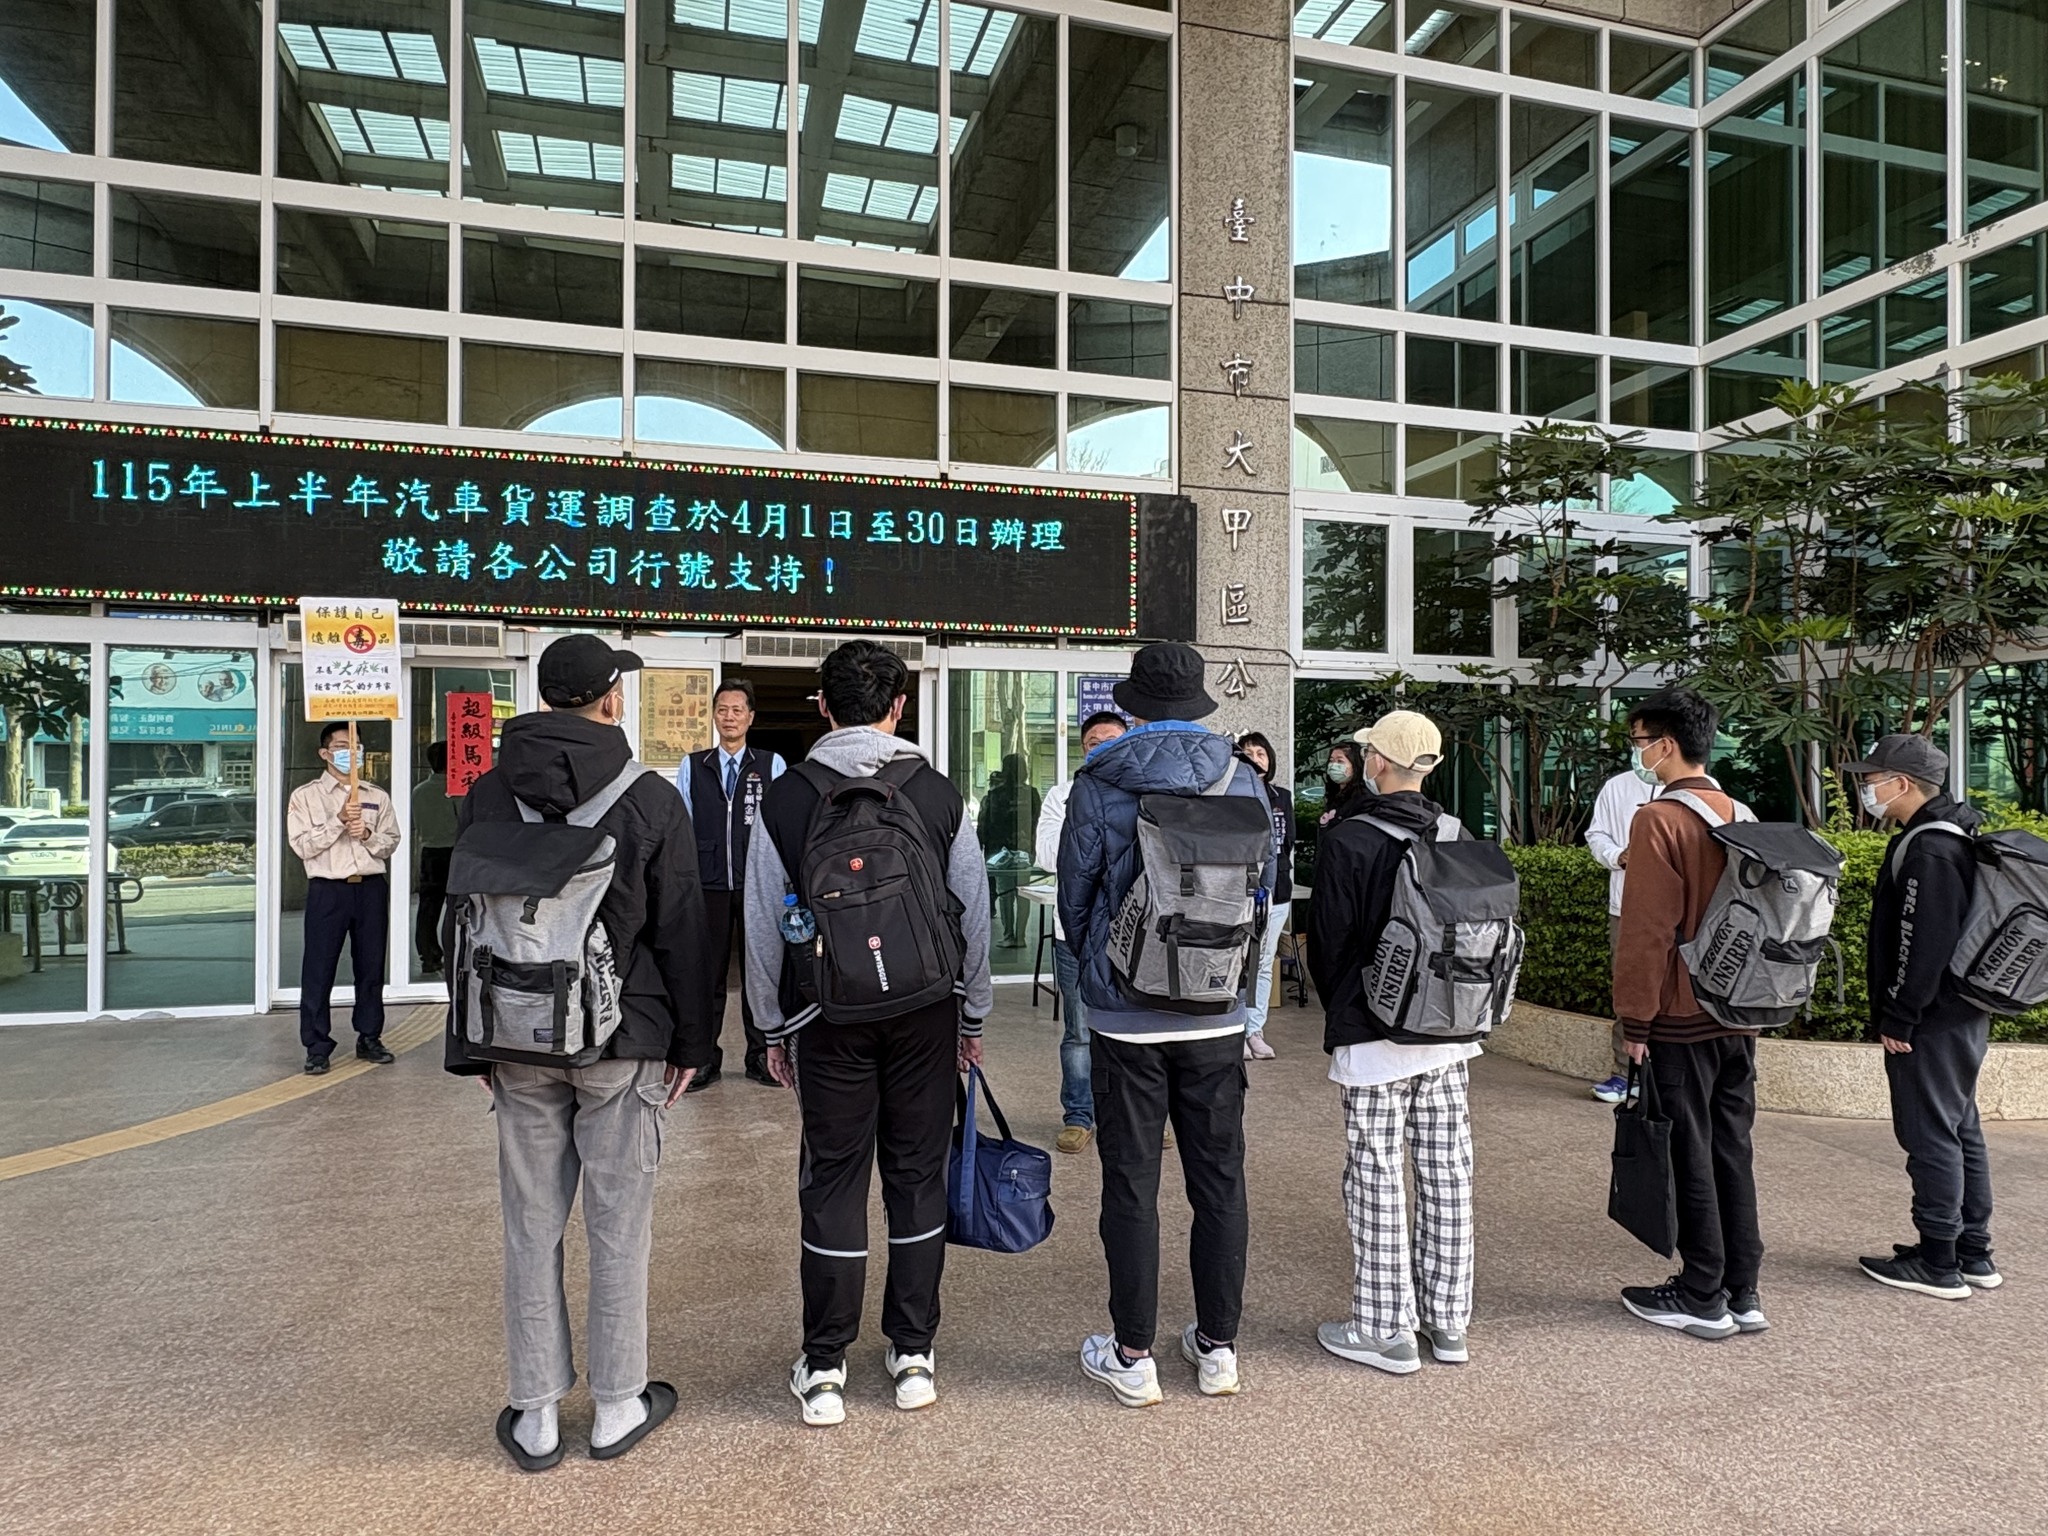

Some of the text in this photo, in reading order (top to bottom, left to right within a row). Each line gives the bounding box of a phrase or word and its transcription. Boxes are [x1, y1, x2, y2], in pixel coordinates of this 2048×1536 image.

[1217, 197, 1256, 743] 臺中市大甲區公
[316, 605, 384, 620] 保護自己
[311, 627, 390, 649] 遠離毒品
[1083, 682, 1114, 691] 臺中市
[1902, 877, 1919, 916] SPEC.
[873, 950, 889, 992] SWISSGEAR
[1700, 921, 1735, 976] FASHION
[1711, 929, 1755, 990] INSIRER
[1977, 926, 2027, 982] FASHION
[1994, 937, 2047, 990] INSIRER
[1378, 944, 1413, 1012] INSIRER
[1347, 1331, 1361, 1344] N
